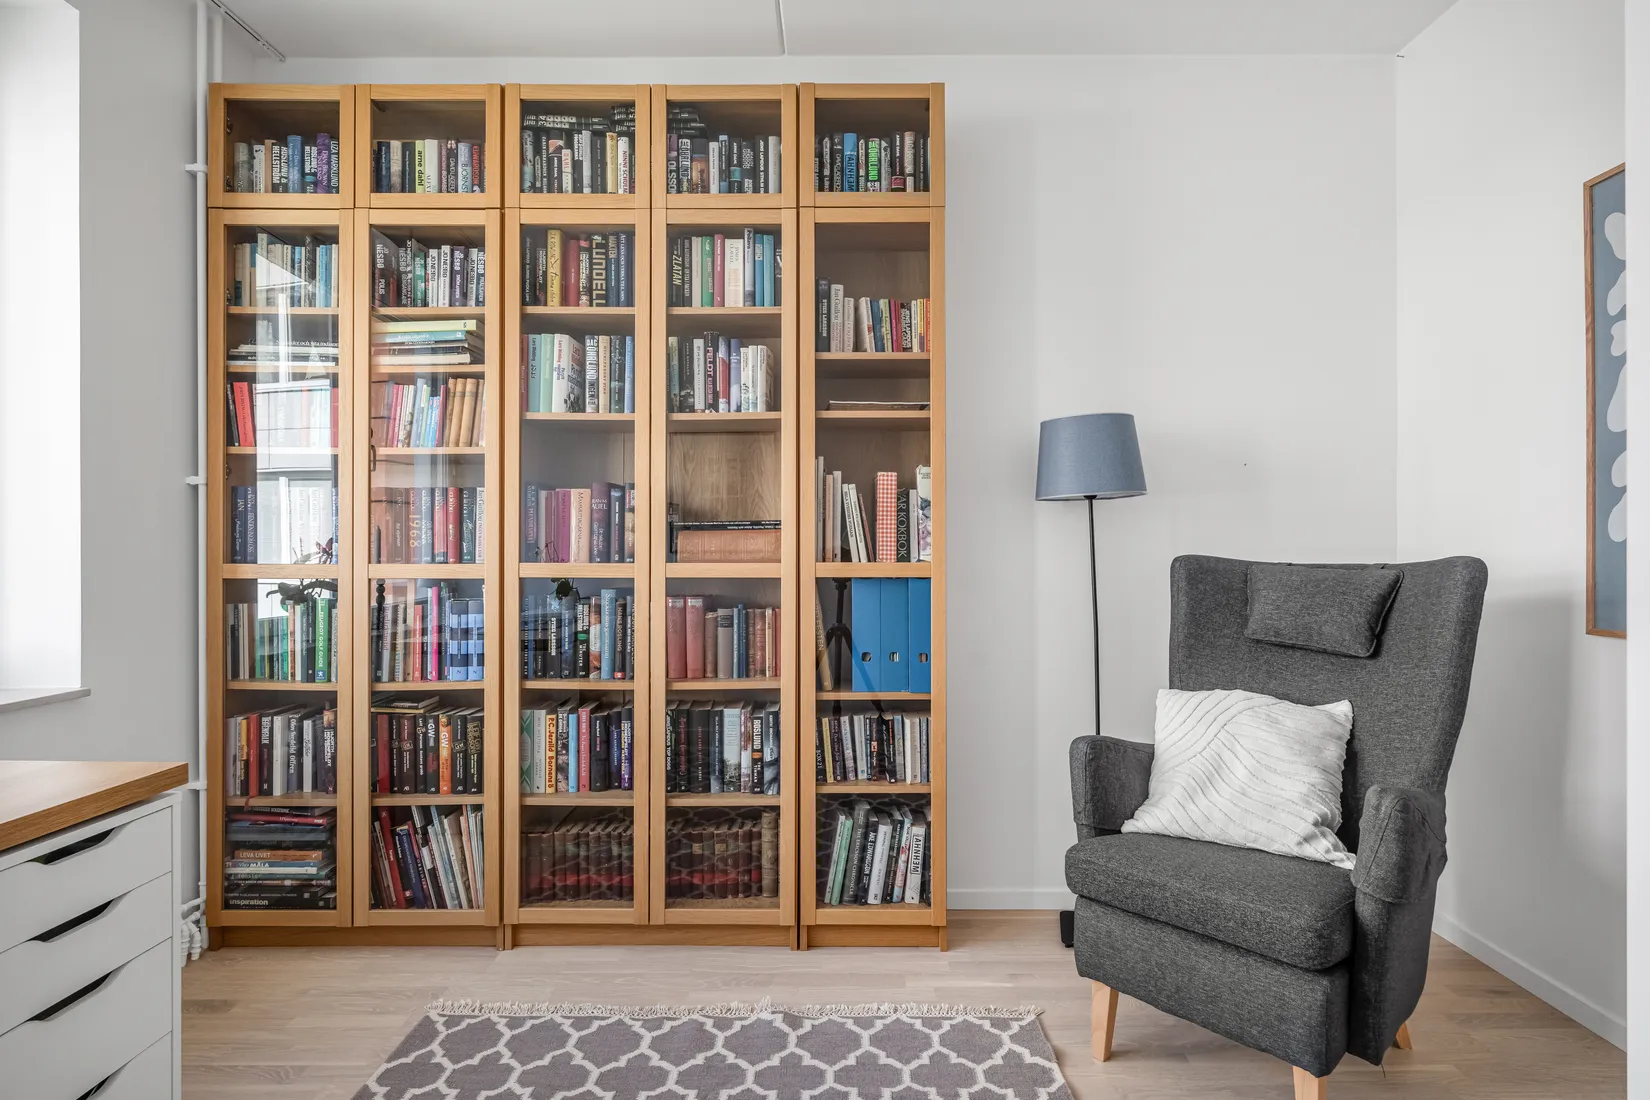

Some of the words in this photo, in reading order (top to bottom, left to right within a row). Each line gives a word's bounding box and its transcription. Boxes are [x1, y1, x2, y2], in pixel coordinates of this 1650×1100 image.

[330, 141, 338, 154] LIZA
[330, 155, 338, 187] MARKLUND
[592, 240, 606, 307] LUNDELL
[672, 255, 682, 286] ZLATAN
[586, 346, 598, 380] ÖHRLUND
[409, 514, 422, 548] 1968
[898, 512, 908, 558] KOKBOK
[428, 724, 435, 738] GW
[442, 732, 448, 748] GW
[849, 865, 858, 895] CHRONICLE
